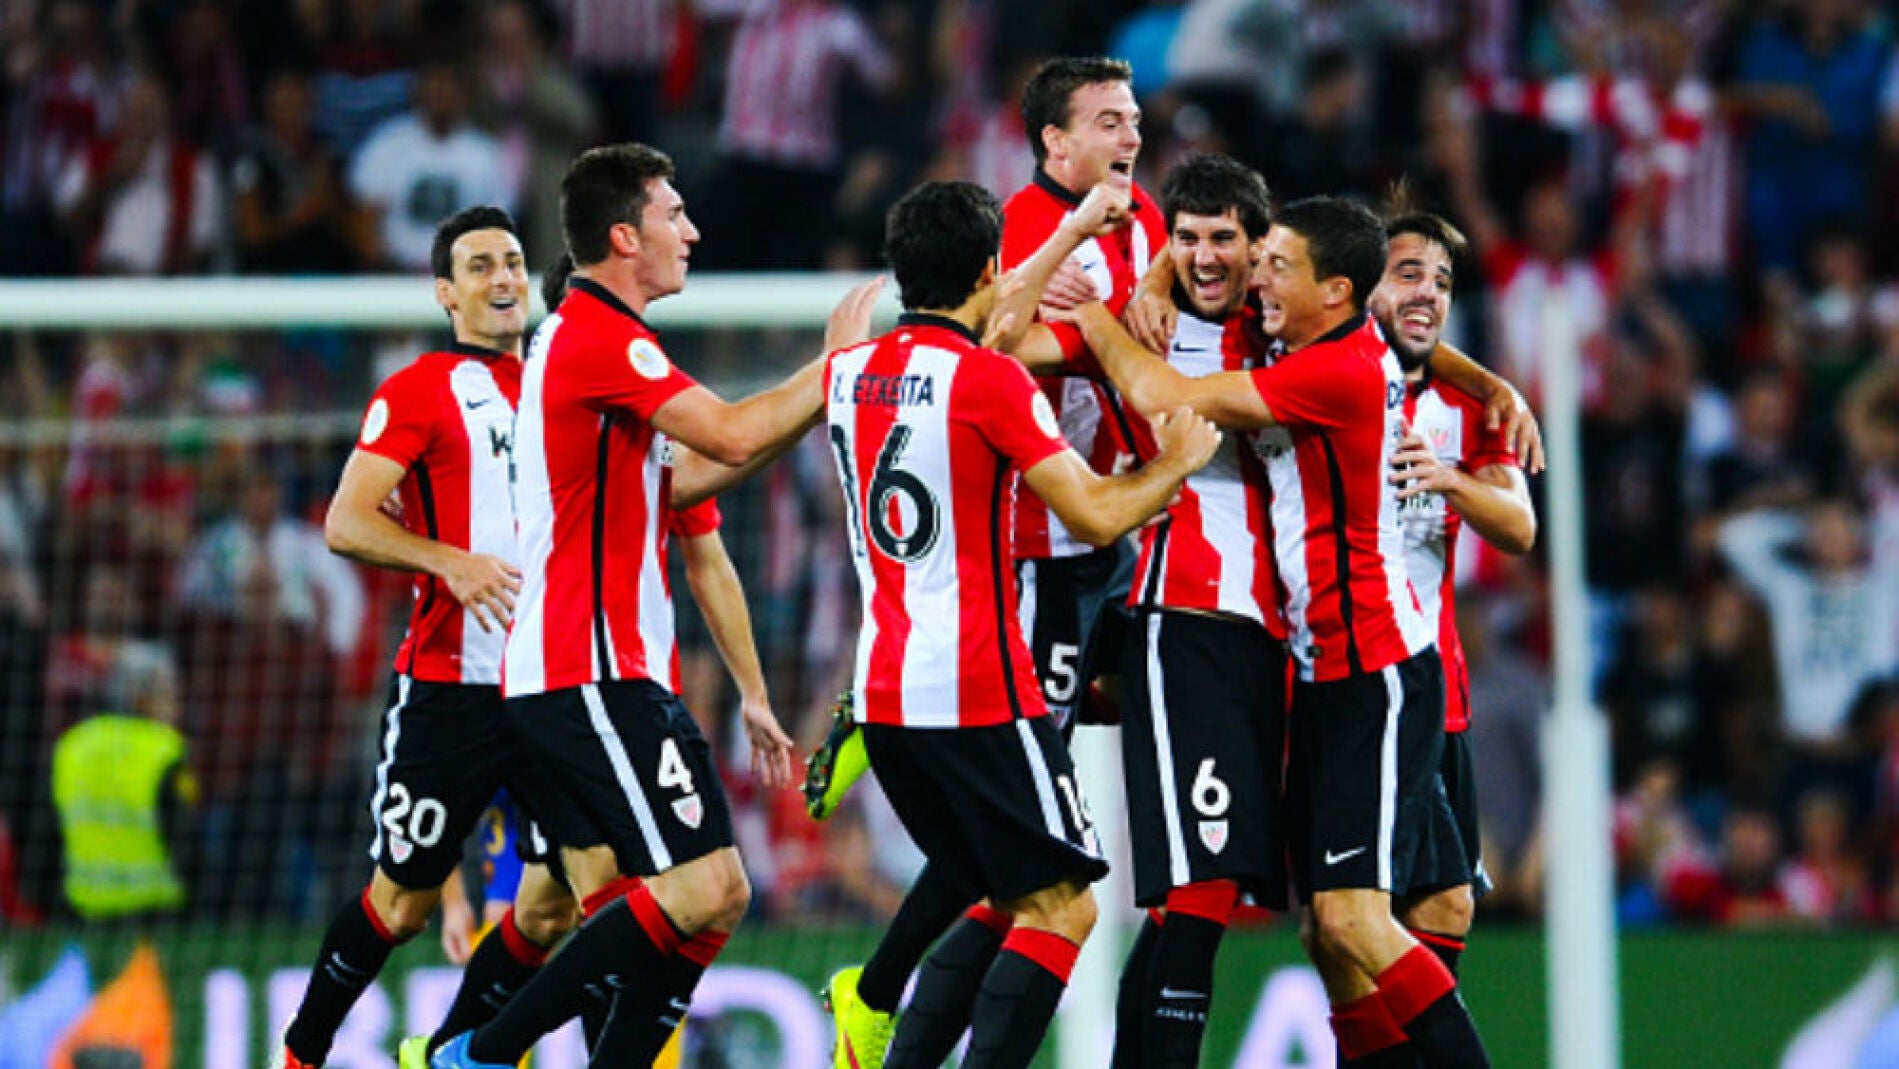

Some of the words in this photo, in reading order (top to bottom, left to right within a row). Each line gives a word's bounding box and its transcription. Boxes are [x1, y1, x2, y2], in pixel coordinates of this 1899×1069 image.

[831, 424, 941, 562] 16
[1044, 642, 1078, 701] 5
[658, 738, 694, 793] 4
[1191, 757, 1231, 817] 6
[382, 783, 447, 848] 20
